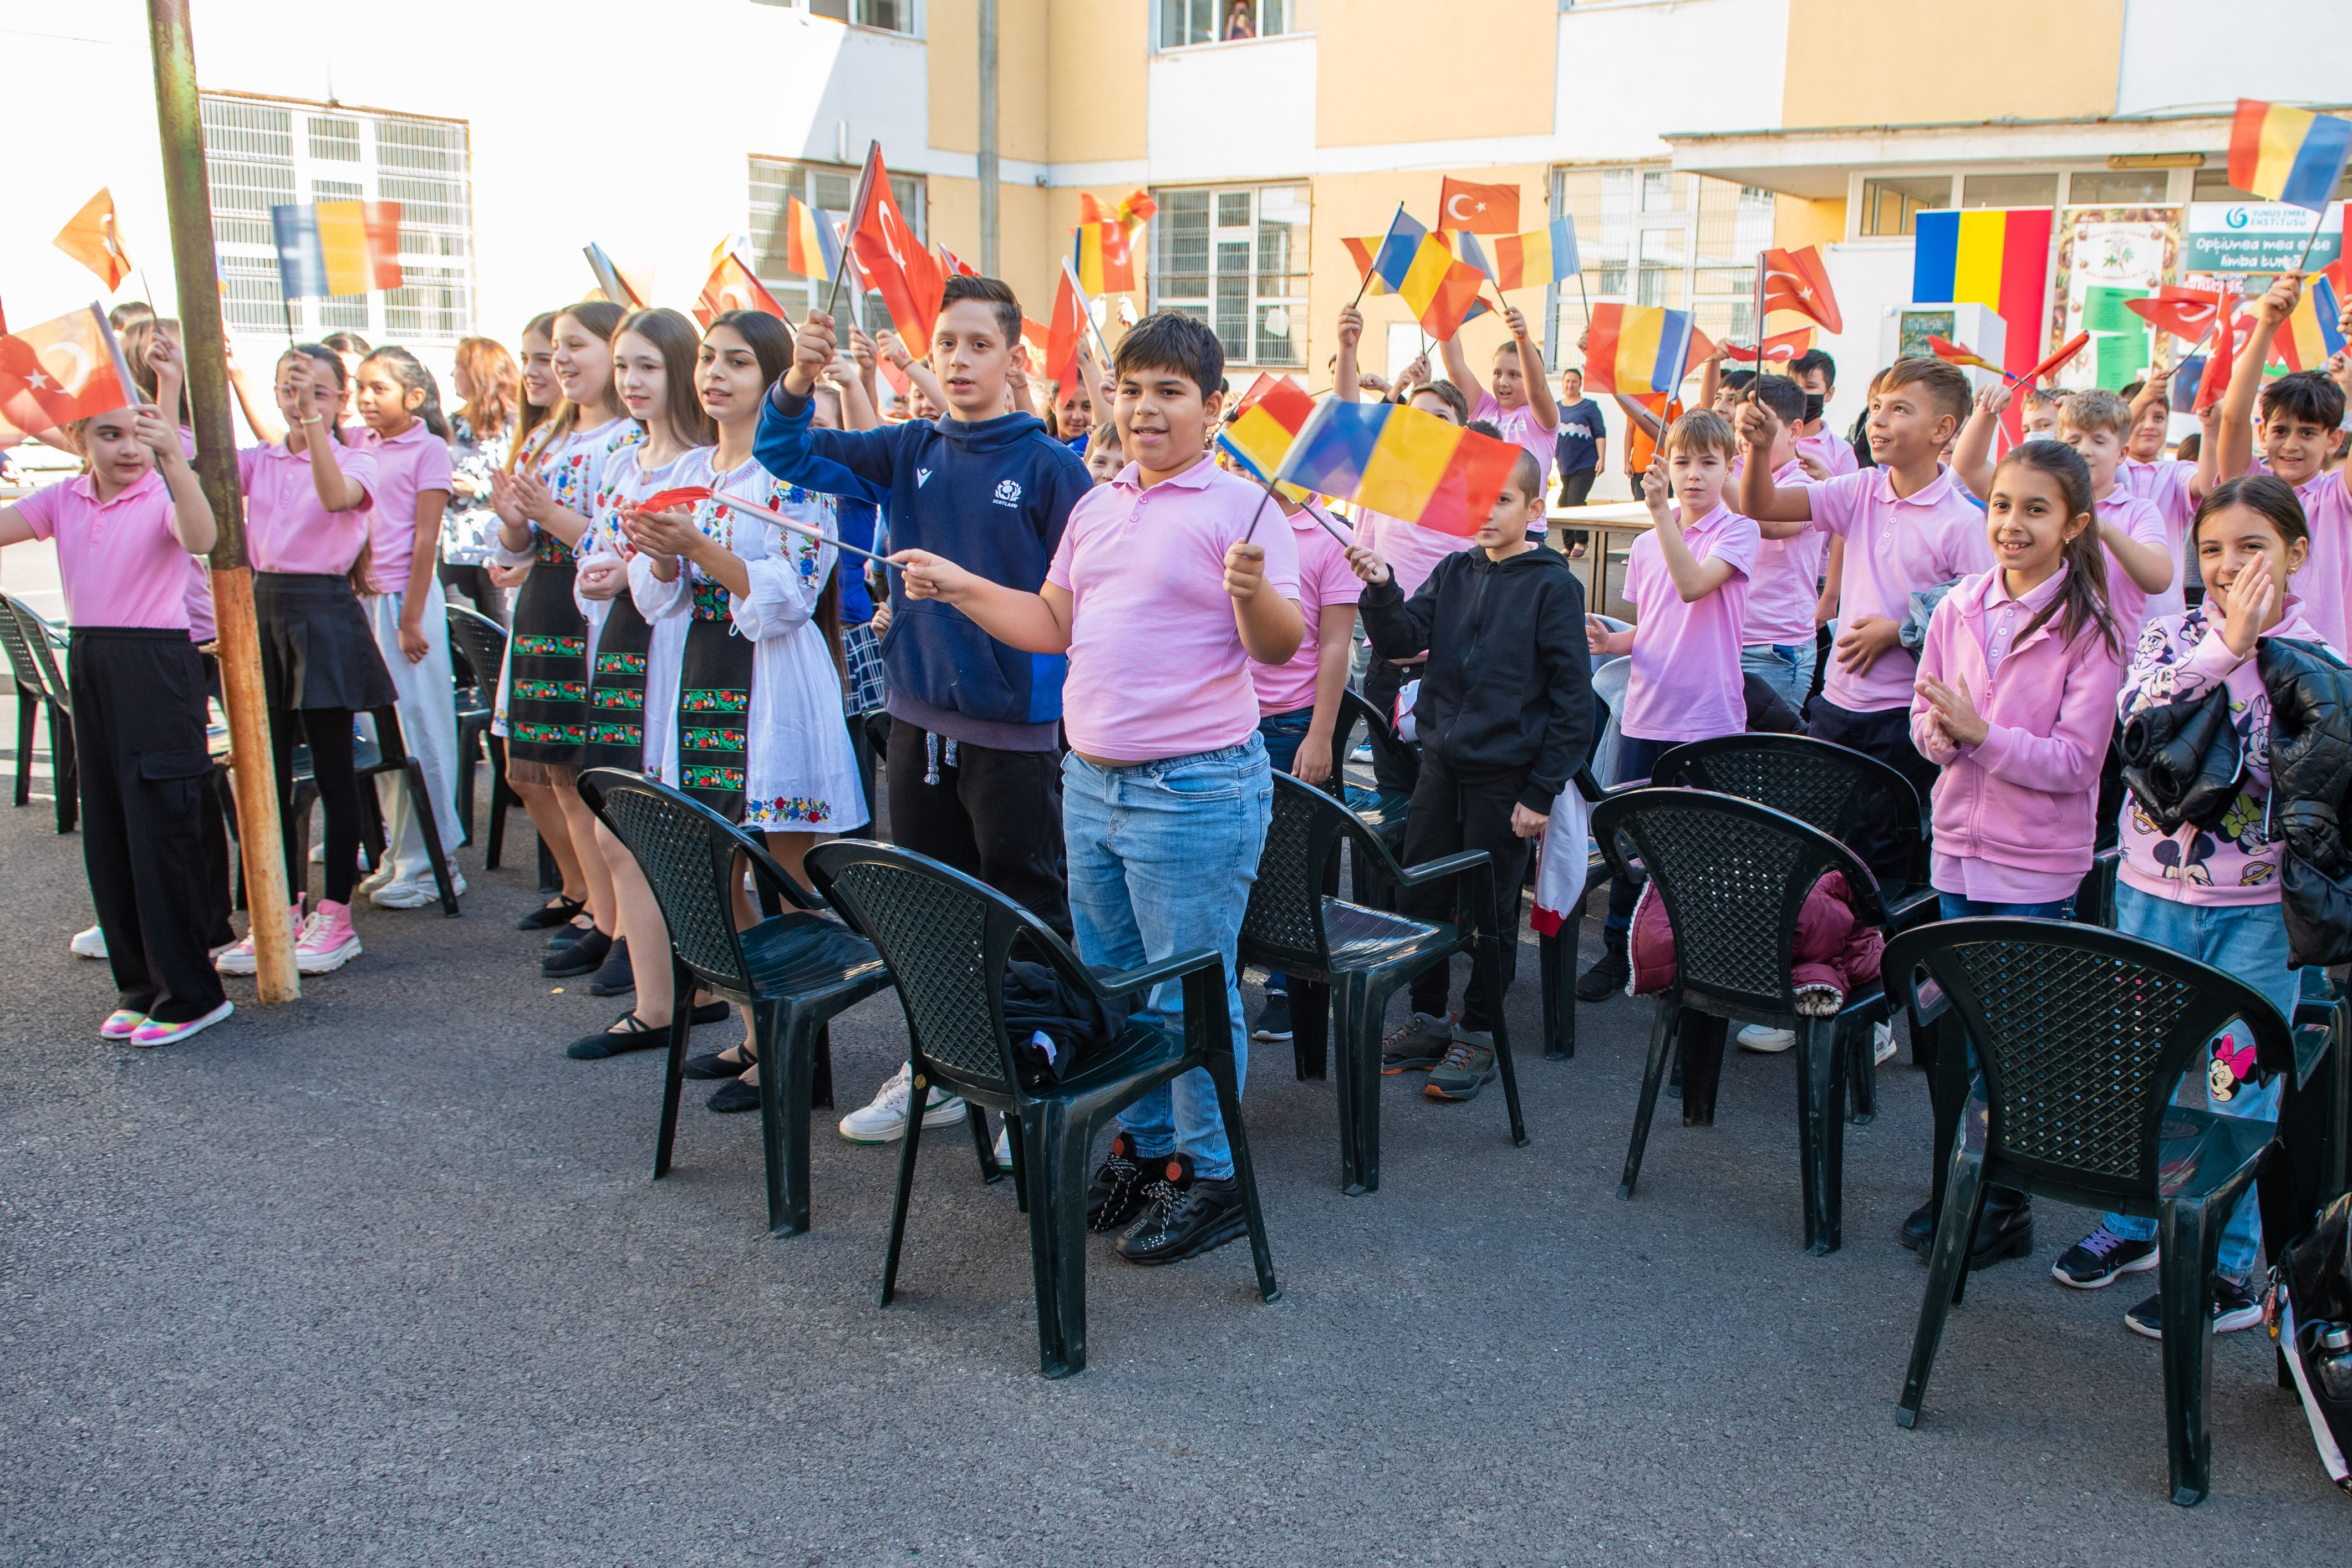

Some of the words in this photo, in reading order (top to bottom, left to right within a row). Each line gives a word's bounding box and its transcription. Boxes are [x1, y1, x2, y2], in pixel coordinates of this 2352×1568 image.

[2196, 237, 2259, 255] Opțiunea
[2262, 240, 2294, 251] mea
[2220, 253, 2258, 268] limba
[2261, 254, 2300, 268] tură
[992, 499, 1018, 508] SCOTLAND
